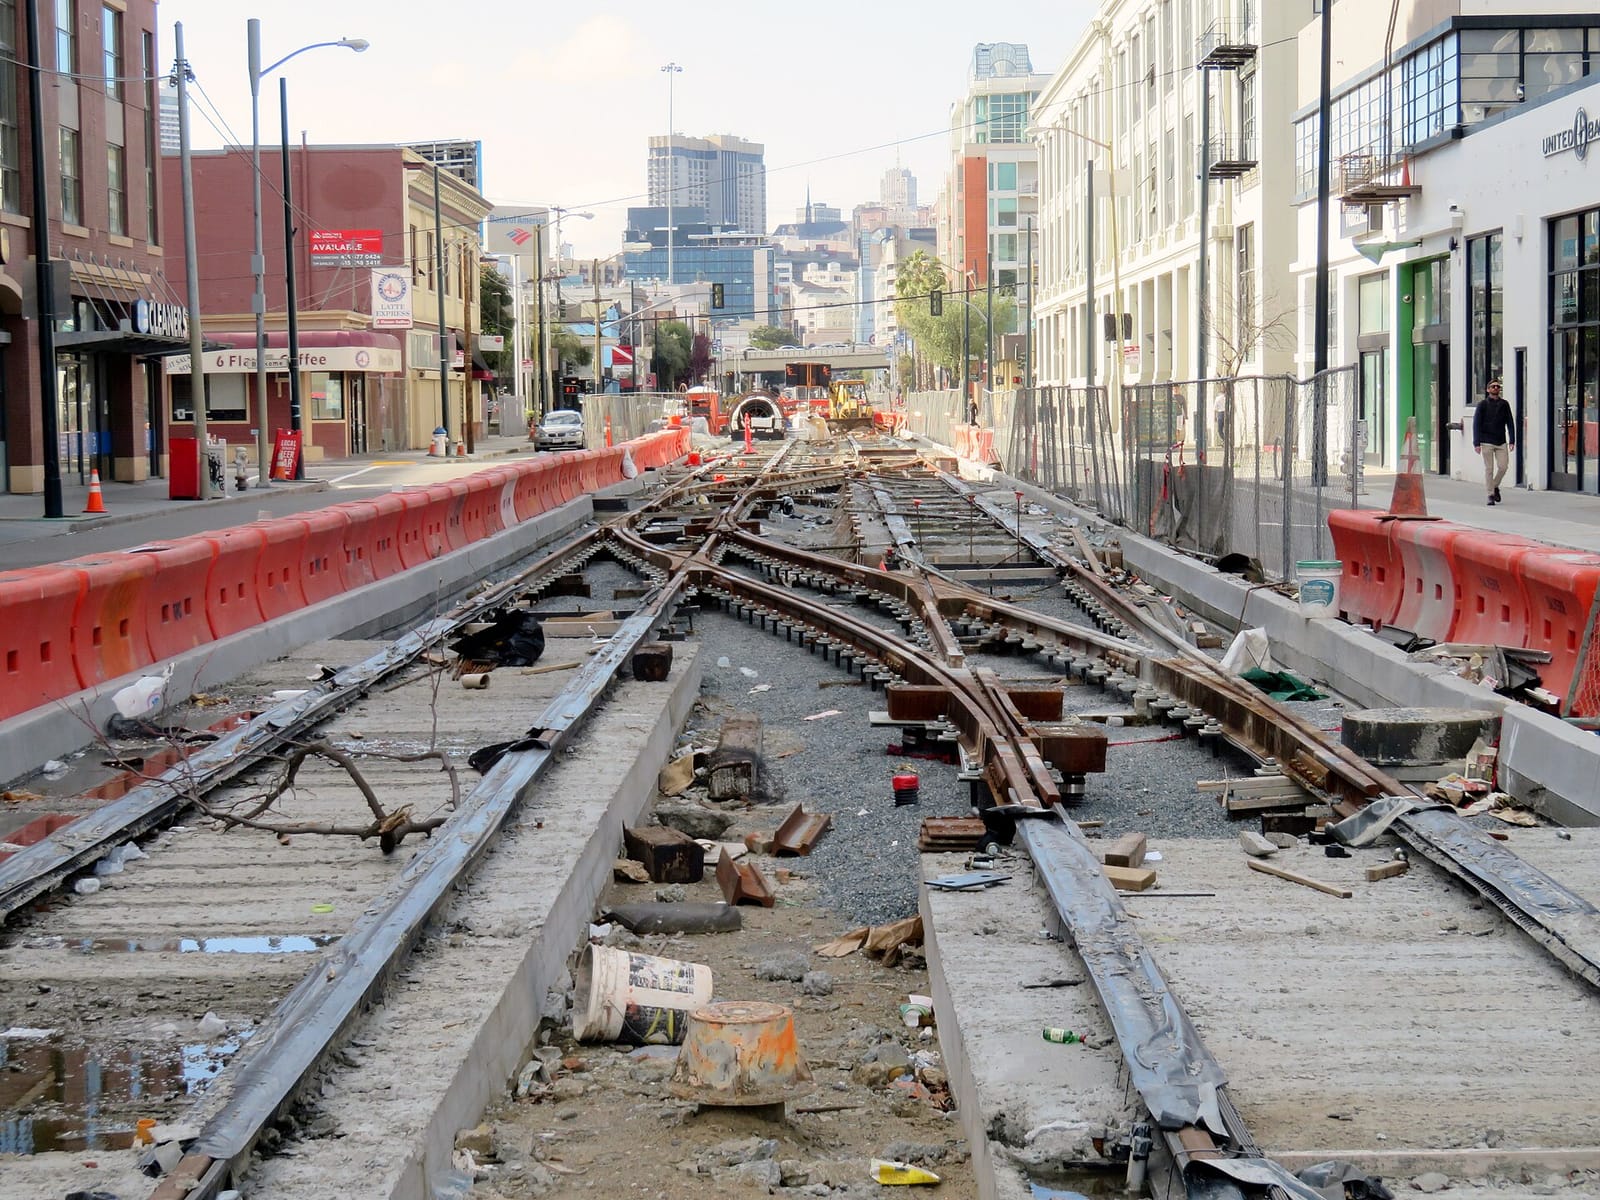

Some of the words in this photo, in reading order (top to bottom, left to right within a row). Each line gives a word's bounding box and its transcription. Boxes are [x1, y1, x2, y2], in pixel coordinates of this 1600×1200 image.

[1542, 129, 1573, 154] UNITED
[489, 214, 508, 224] Bank
[509, 216, 516, 224] of
[517, 216, 546, 224] America
[149, 302, 187, 339] CLEANERS
[216, 356, 224, 367] 6
